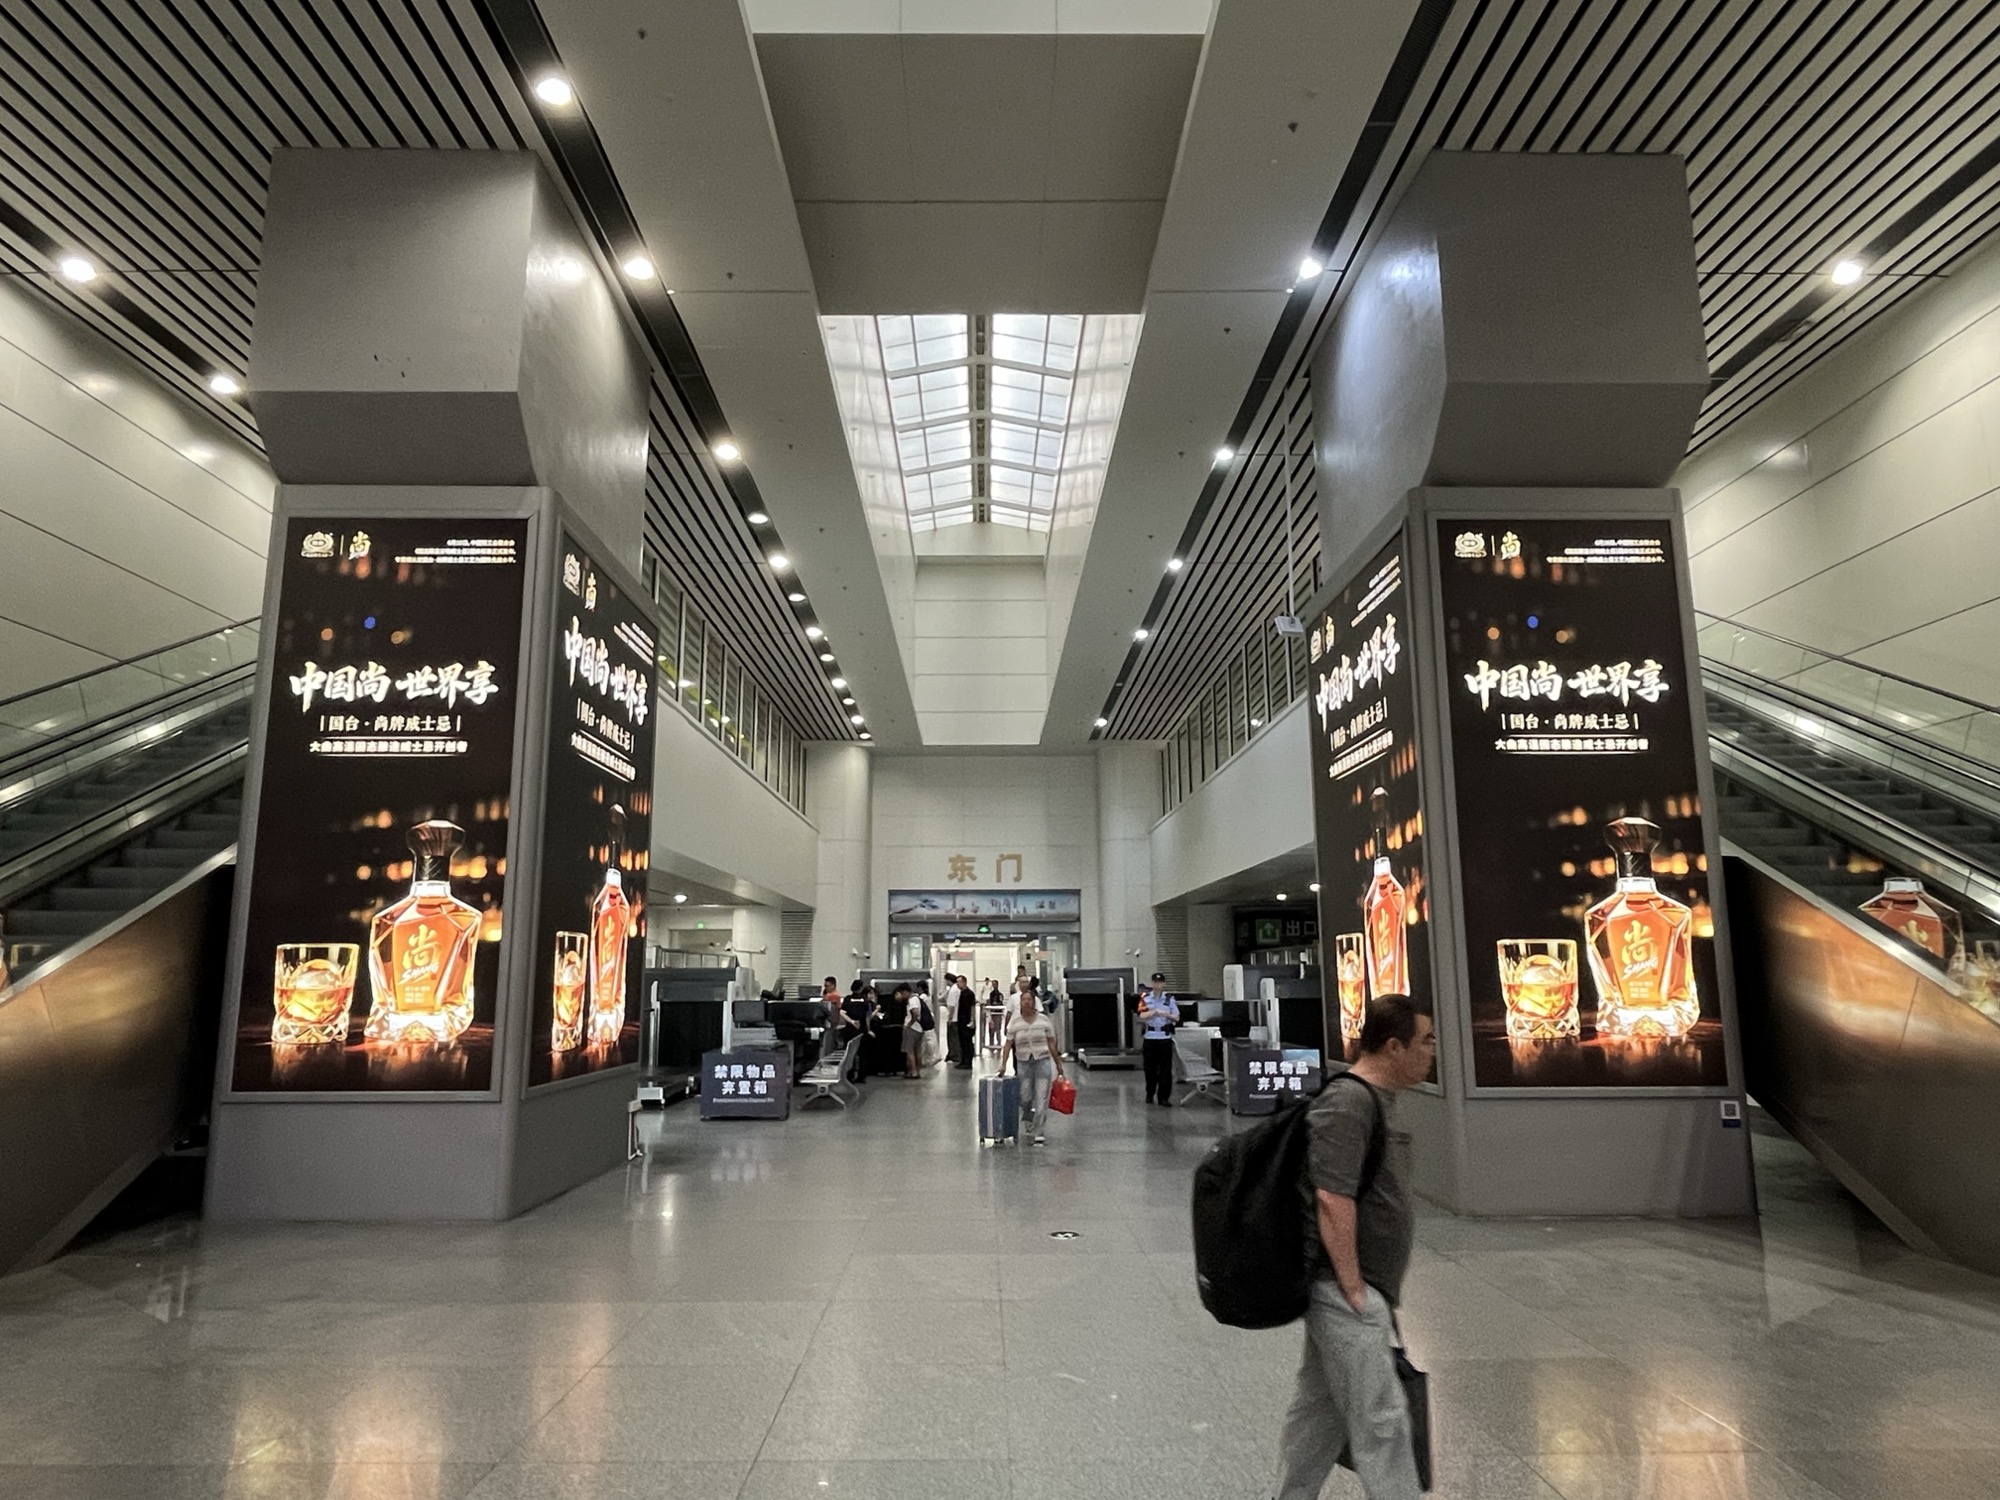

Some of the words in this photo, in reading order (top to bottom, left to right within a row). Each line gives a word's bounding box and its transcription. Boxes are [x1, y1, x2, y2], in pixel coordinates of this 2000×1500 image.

[565, 615, 610, 696] 中国尚
[289, 661, 391, 713] 中国尚
[396, 660, 499, 709] 世界享
[1464, 659, 1563, 712] 中国尚
[1567, 659, 1669, 708] 世界享
[948, 854, 1023, 883] 东门
[1286, 920, 1317, 937] 出口
[401, 923, 440, 968] 尚
[1621, 919, 1656, 964] 尚
[399, 963, 440, 984] SHANG
[1622, 957, 1659, 979] SHANG
[714, 1064, 776, 1079] 禁限物品
[1249, 1061, 1309, 1075] 禁限物品
[721, 1080, 767, 1095] 弃置箱
